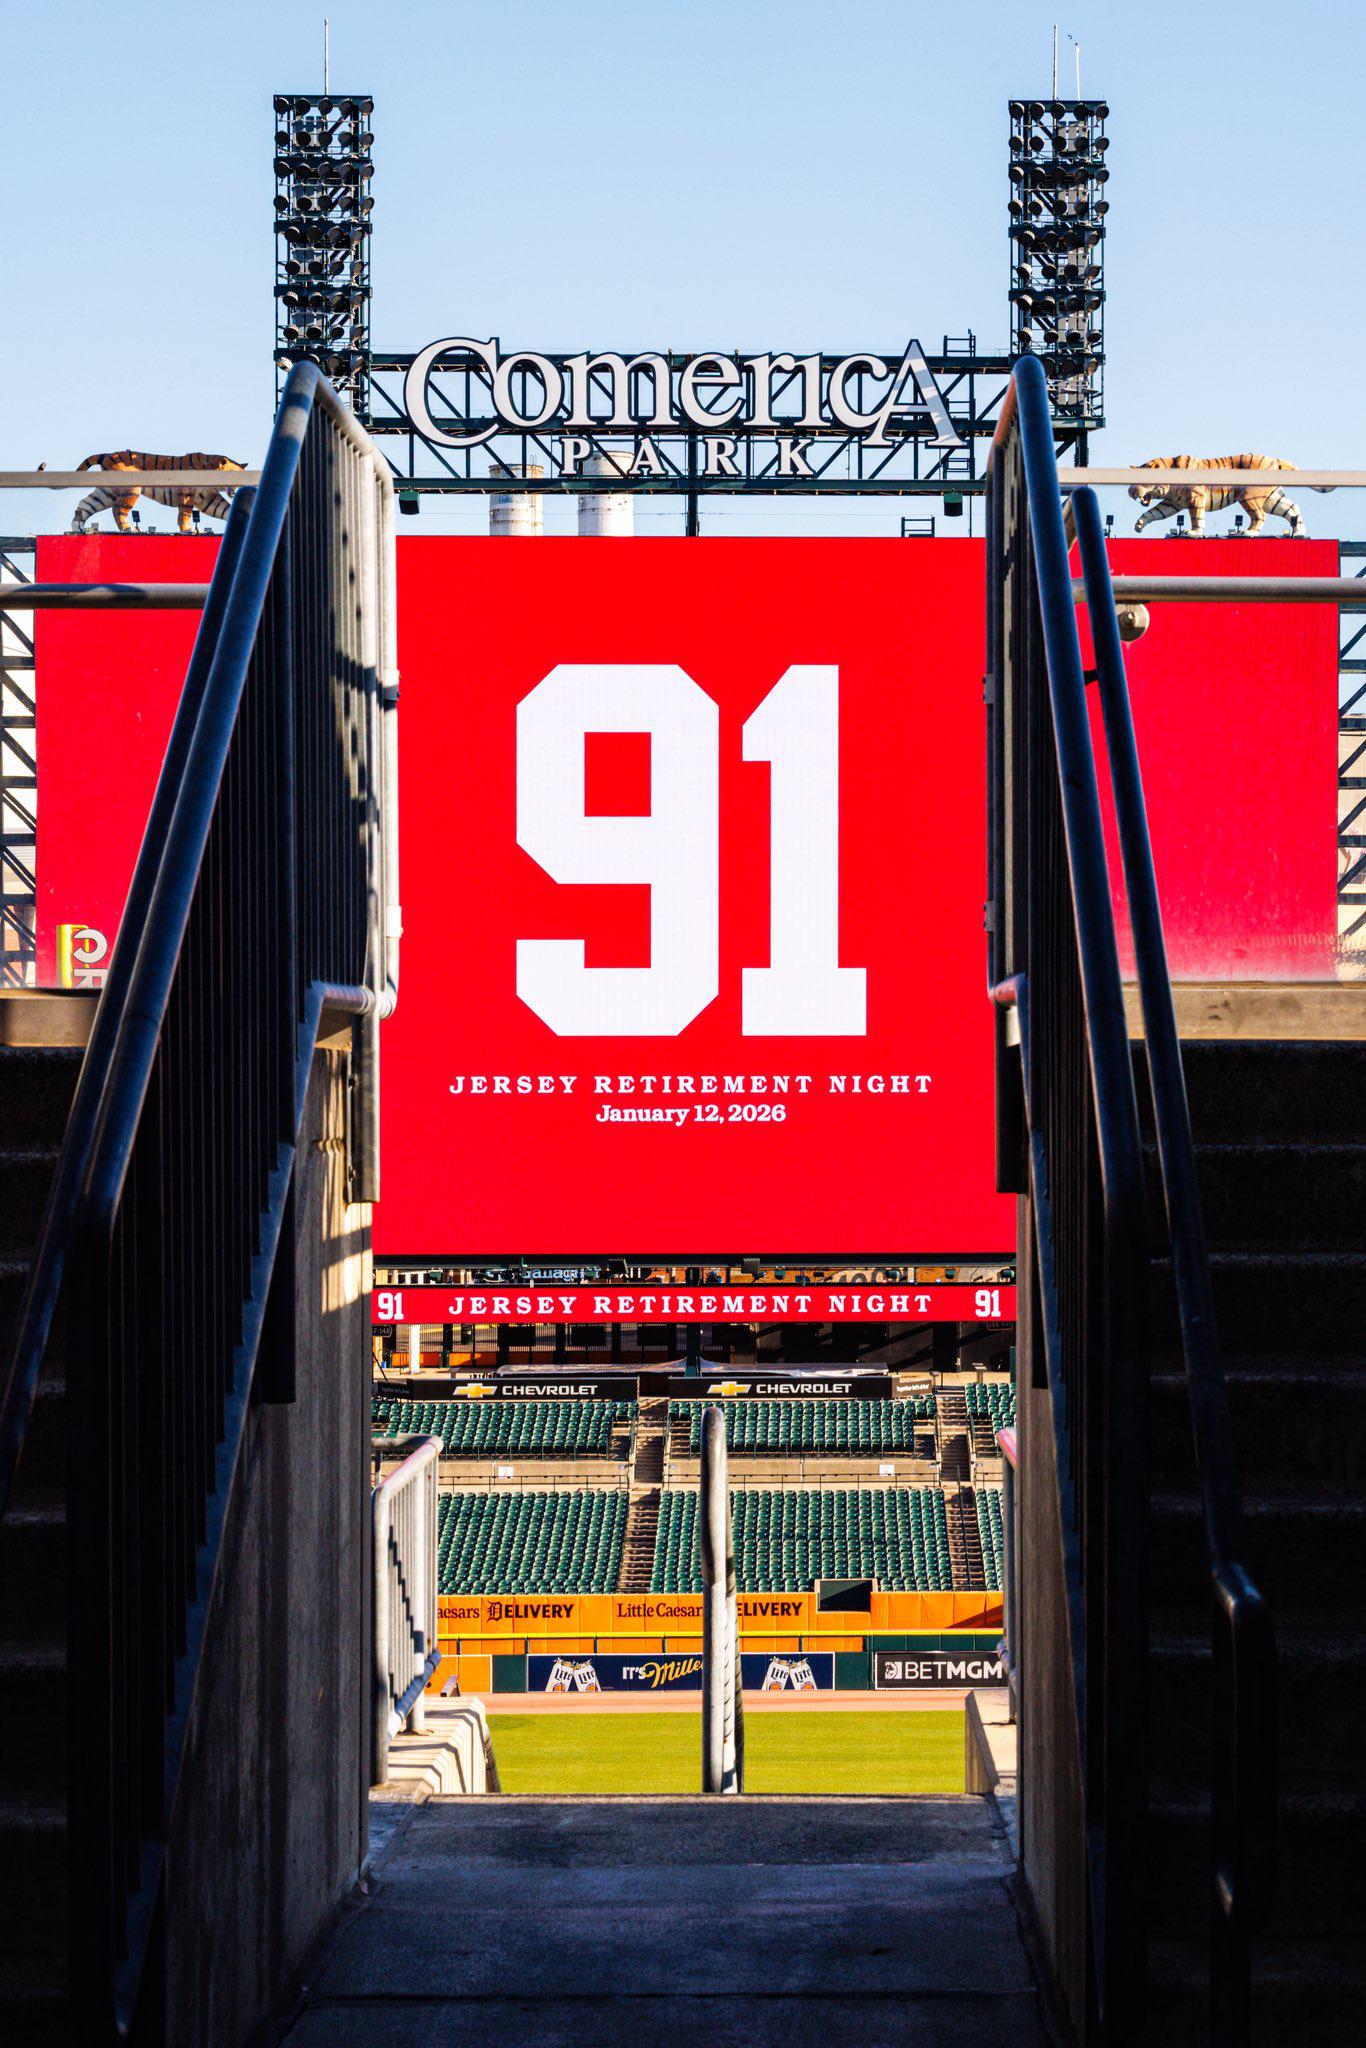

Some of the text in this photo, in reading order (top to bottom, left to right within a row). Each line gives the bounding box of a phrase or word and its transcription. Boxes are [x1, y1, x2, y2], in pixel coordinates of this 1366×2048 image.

[559, 437, 815, 477] PARK
[515, 663, 868, 1037] 91
[449, 1075, 932, 1095] JERSEY RETIREMENT NIGHT
[595, 1103, 787, 1127] January 12, 2026
[377, 1292, 405, 1321] 91
[448, 1294, 932, 1315] JERSEY RETIREMENT NIGHT
[975, 1289, 1002, 1318] 91
[502, 1385, 598, 1396] CHEVROLET
[756, 1383, 853, 1394] CHEVROLET
[438, 1601, 574, 1622] aesars DELIVERY
[618, 1602, 703, 1618] Little Caesar
[736, 1601, 803, 1617] ELIVERY
[554, 1667, 573, 1682] Lite
[578, 1668, 597, 1684] Lite
[642, 1658, 704, 1689] Mille
[770, 1667, 789, 1680] Lite
[794, 1668, 812, 1683] Lite
[904, 1661, 1003, 1680] BETMGM
